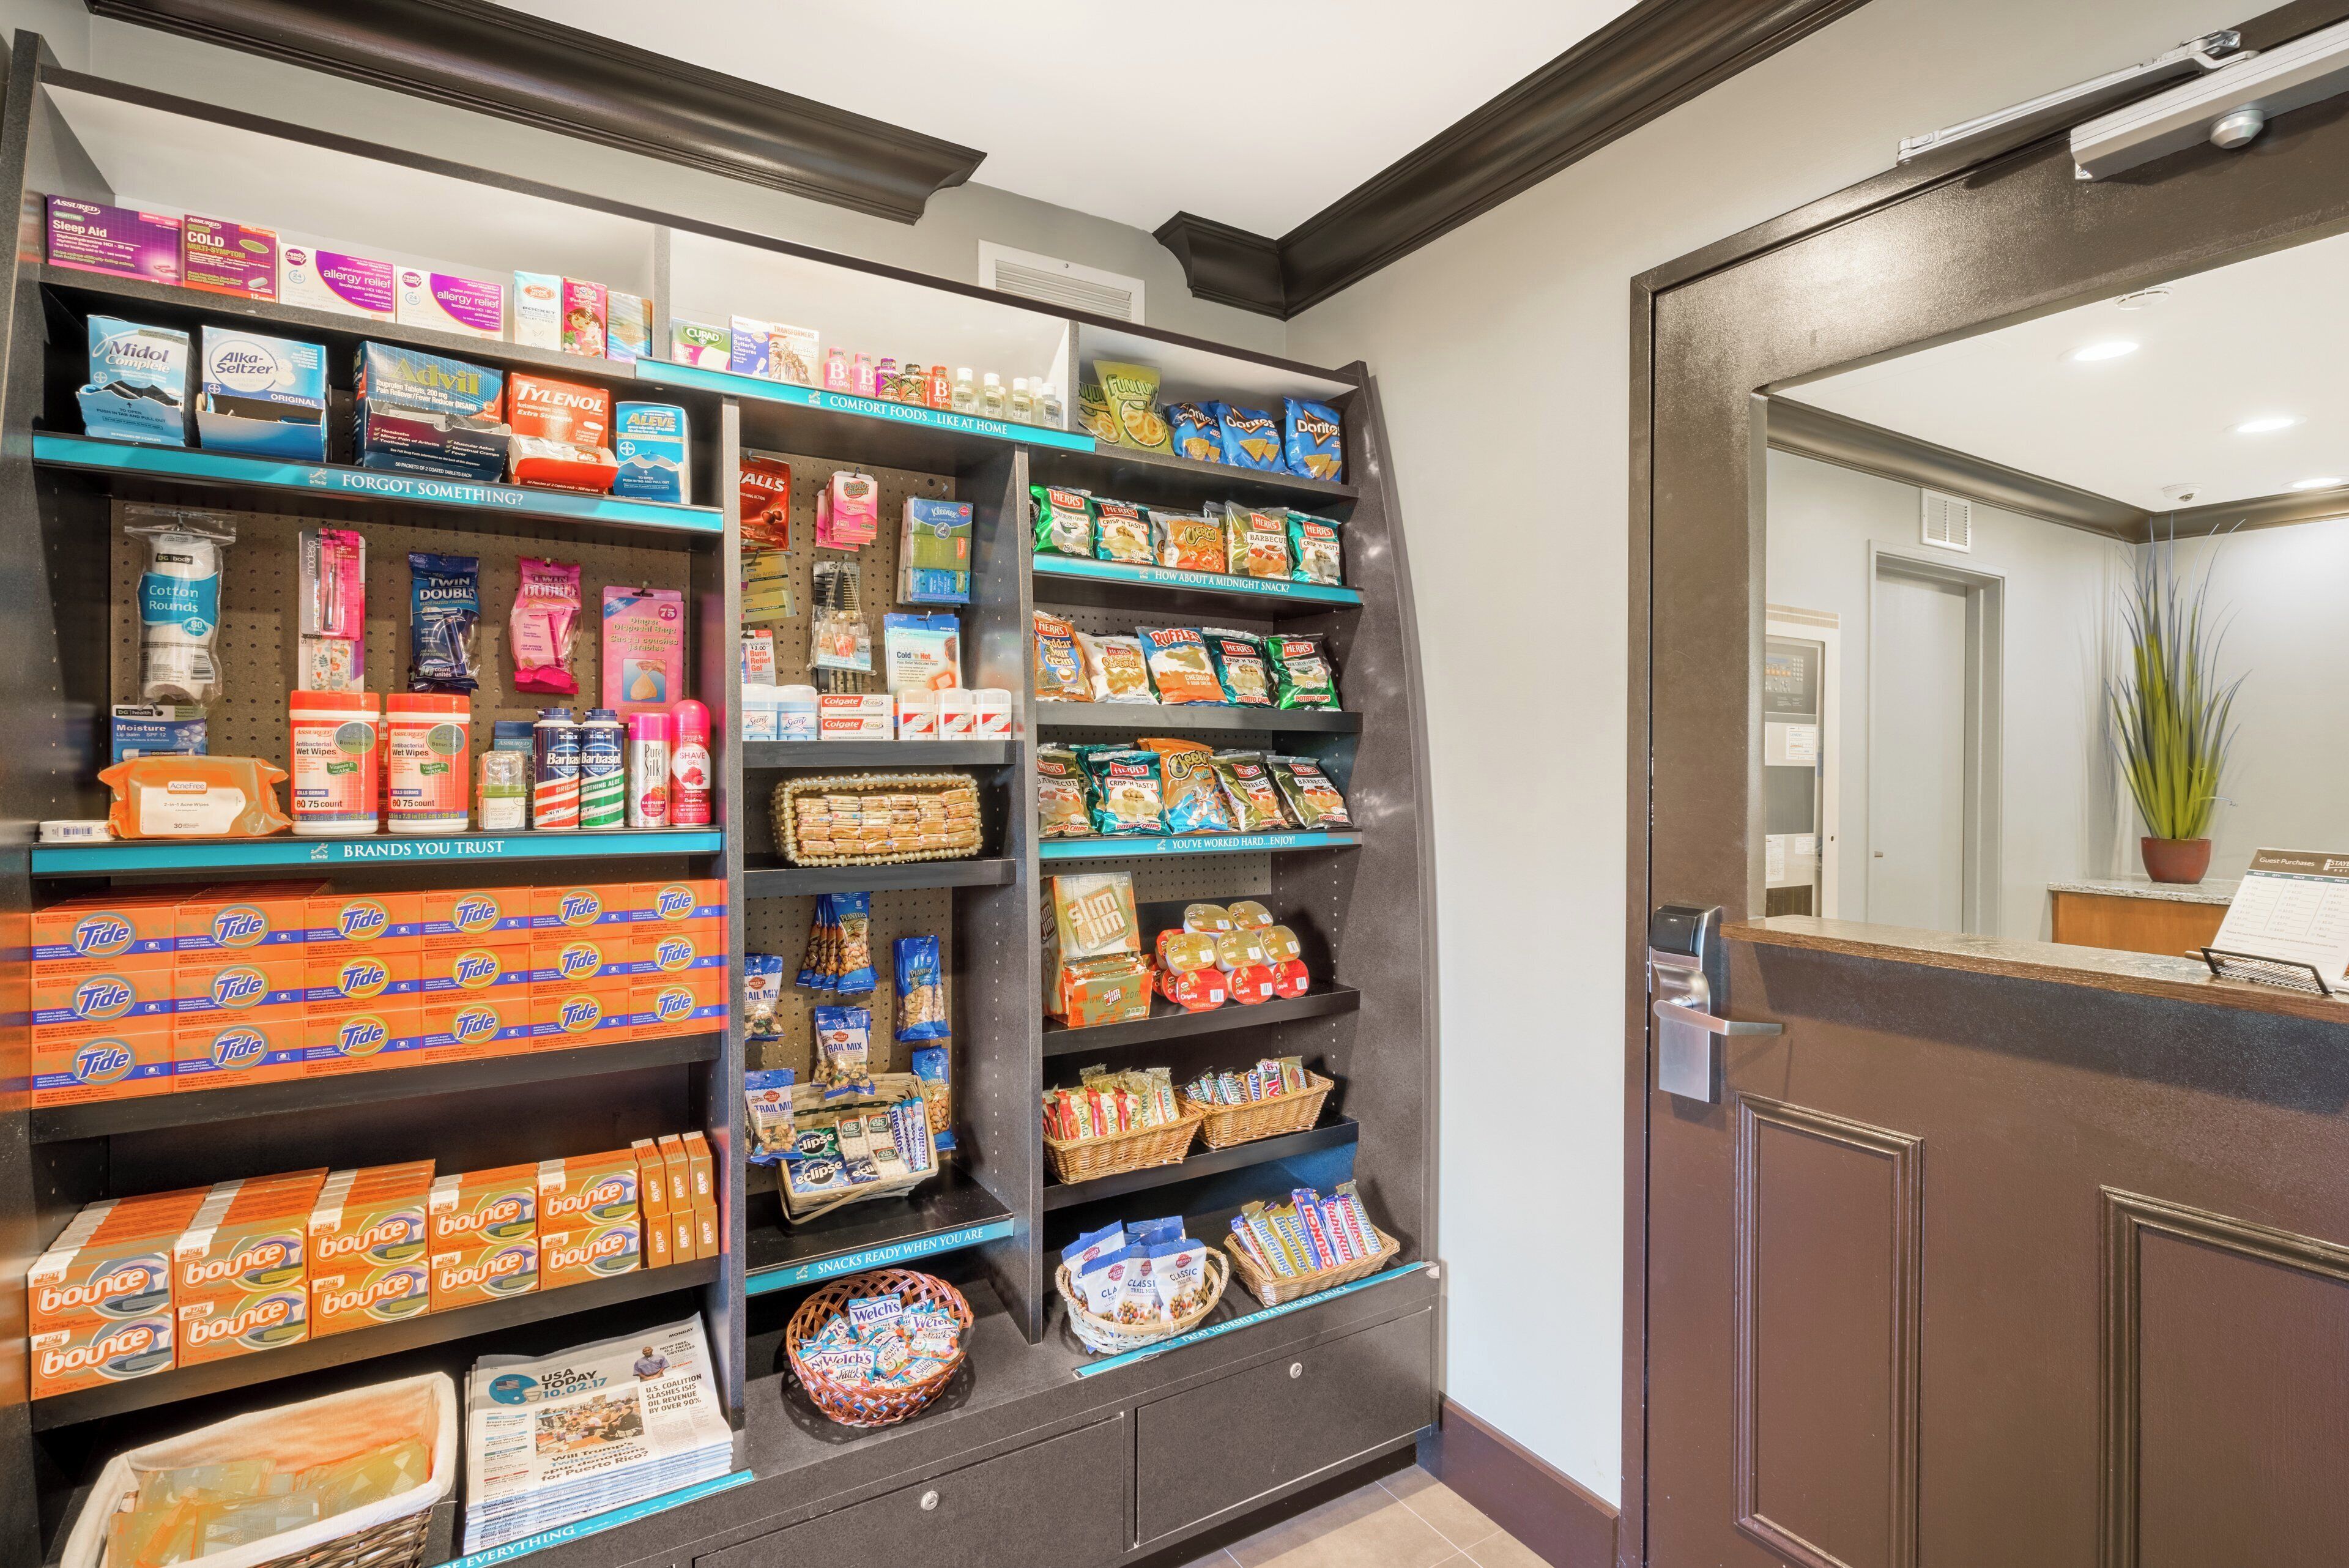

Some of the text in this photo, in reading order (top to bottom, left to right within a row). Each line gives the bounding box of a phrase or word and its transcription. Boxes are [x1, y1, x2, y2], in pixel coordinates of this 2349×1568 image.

[53, 220, 106, 237] Sleep Aid
[188, 231, 224, 247] COLD
[187, 242, 245, 258] MULTI-SYMPTOM
[324, 269, 392, 288] allergy relief
[437, 291, 499, 308] allergy relief
[686, 328, 719, 341] CURAD
[734, 334, 751, 343] Sterile
[774, 325, 814, 339] TRANSFORMERS
[109, 341, 169, 362] Midol
[733, 346, 756, 355] Closures
[734, 341, 756, 350] Butterfly
[105, 355, 171, 374] Complete
[219, 352, 264, 363] Alka-
[216, 363, 273, 374] Seltzer
[388, 359, 480, 396] Advil
[377, 379, 404, 391] Ibuprofen
[405, 384, 425, 394] Tablets,
[270, 393, 317, 407] ORIGINAL
[390, 389, 431, 402] Reliever/Fever
[432, 396, 454, 407] Reducer
[455, 401, 477, 411] (NSAID)
[518, 382, 604, 413] TYLENOL
[517, 409, 574, 423] Extra Strength
[626, 414, 676, 427] ALEVE
[829, 395, 886, 414] COMFORT
[962, 417, 974, 428] AT
[976, 421, 1008, 435] HOME
[1226, 415, 1274, 428] Doritos
[452, 445, 478, 455] Menstrual
[454, 440, 478, 449] Muscular
[343, 474, 524, 505] FORGOT SOMETHING?
[1053, 492, 1081, 507] HERR'S
[932, 506, 958, 518] Kleenex
[1106, 507, 1134, 516] HERR'S
[1184, 526, 1216, 545] Cheetos
[429, 577, 470, 587] TWIN
[1156, 570, 1178, 581] HOW
[1179, 574, 1208, 584] ABOUT
[1216, 578, 1259, 590] MIDNIGHT
[1261, 582, 1290, 592] SNACK?
[149, 585, 199, 598] Cotton
[420, 587, 473, 600] DOUBLE
[149, 600, 199, 613] Rounds
[659, 608, 675, 617] 75
[614, 624, 652, 633] Disposal
[631, 618, 660, 626] Diaper
[1039, 634, 1071, 648] Cheddar
[1150, 629, 1203, 647] RUFFLES
[1045, 656, 1075, 665] Cream
[824, 697, 859, 707] Colgate
[825, 721, 859, 730] Colgate
[581, 752, 622, 765] Barbasol
[645, 744, 662, 758] Pure
[645, 759, 661, 777] Silk
[344, 841, 505, 857] BRANDS YOU TRUST
[1173, 839, 1201, 849] YOU'VE
[1203, 838, 1239, 847] WORKED
[562, 897, 598, 923] Tide
[658, 892, 692, 915] Tide
[1067, 891, 1118, 927] slim
[840, 912, 867, 921] PLANTERS
[216, 914, 265, 943] Tide
[1086, 910, 1126, 948] jim
[76, 922, 132, 952] Tide
[796, 1161, 843, 1184] eclipse
[546, 1180, 624, 1217] bounce
[437, 1200, 521, 1238] bounce
[316, 1219, 410, 1261] bounce
[1304, 1207, 1335, 1268] CRUNCH
[817, 1228, 984, 1274] SNACKS READY WHEN YOU ARE
[185, 1244, 286, 1287] bounce
[1170, 1268, 1198, 1281] CLASSIC
[853, 1301, 900, 1323] Welch's
[1181, 1329, 1209, 1342] TREAT
[1209, 1315, 1255, 1334] YOURSELF
[1275, 1295, 1322, 1312] DELICIOUS
[1321, 1285, 1351, 1298] SNACK
[669, 1328, 693, 1338] MONDAY
[667, 1345, 695, 1356] OBSTACLES
[822, 1353, 872, 1365] Welch's
[541, 1369, 574, 1383] USA
[541, 1370, 598, 1390] TODAY
[662, 1373, 702, 1389] COALITION
[544, 1377, 608, 1399] 10.02.17
[647, 1383, 696, 1400] SLASHES ISIS
[662, 1391, 697, 1403] REVENUE
[684, 1397, 701, 1406] 90%
[581, 1441, 633, 1455] Trump's
[566, 1462, 612, 1476] Puerto
[615, 1451, 648, 1463] Rico?
[467, 1526, 576, 1567] EVERYTHING
